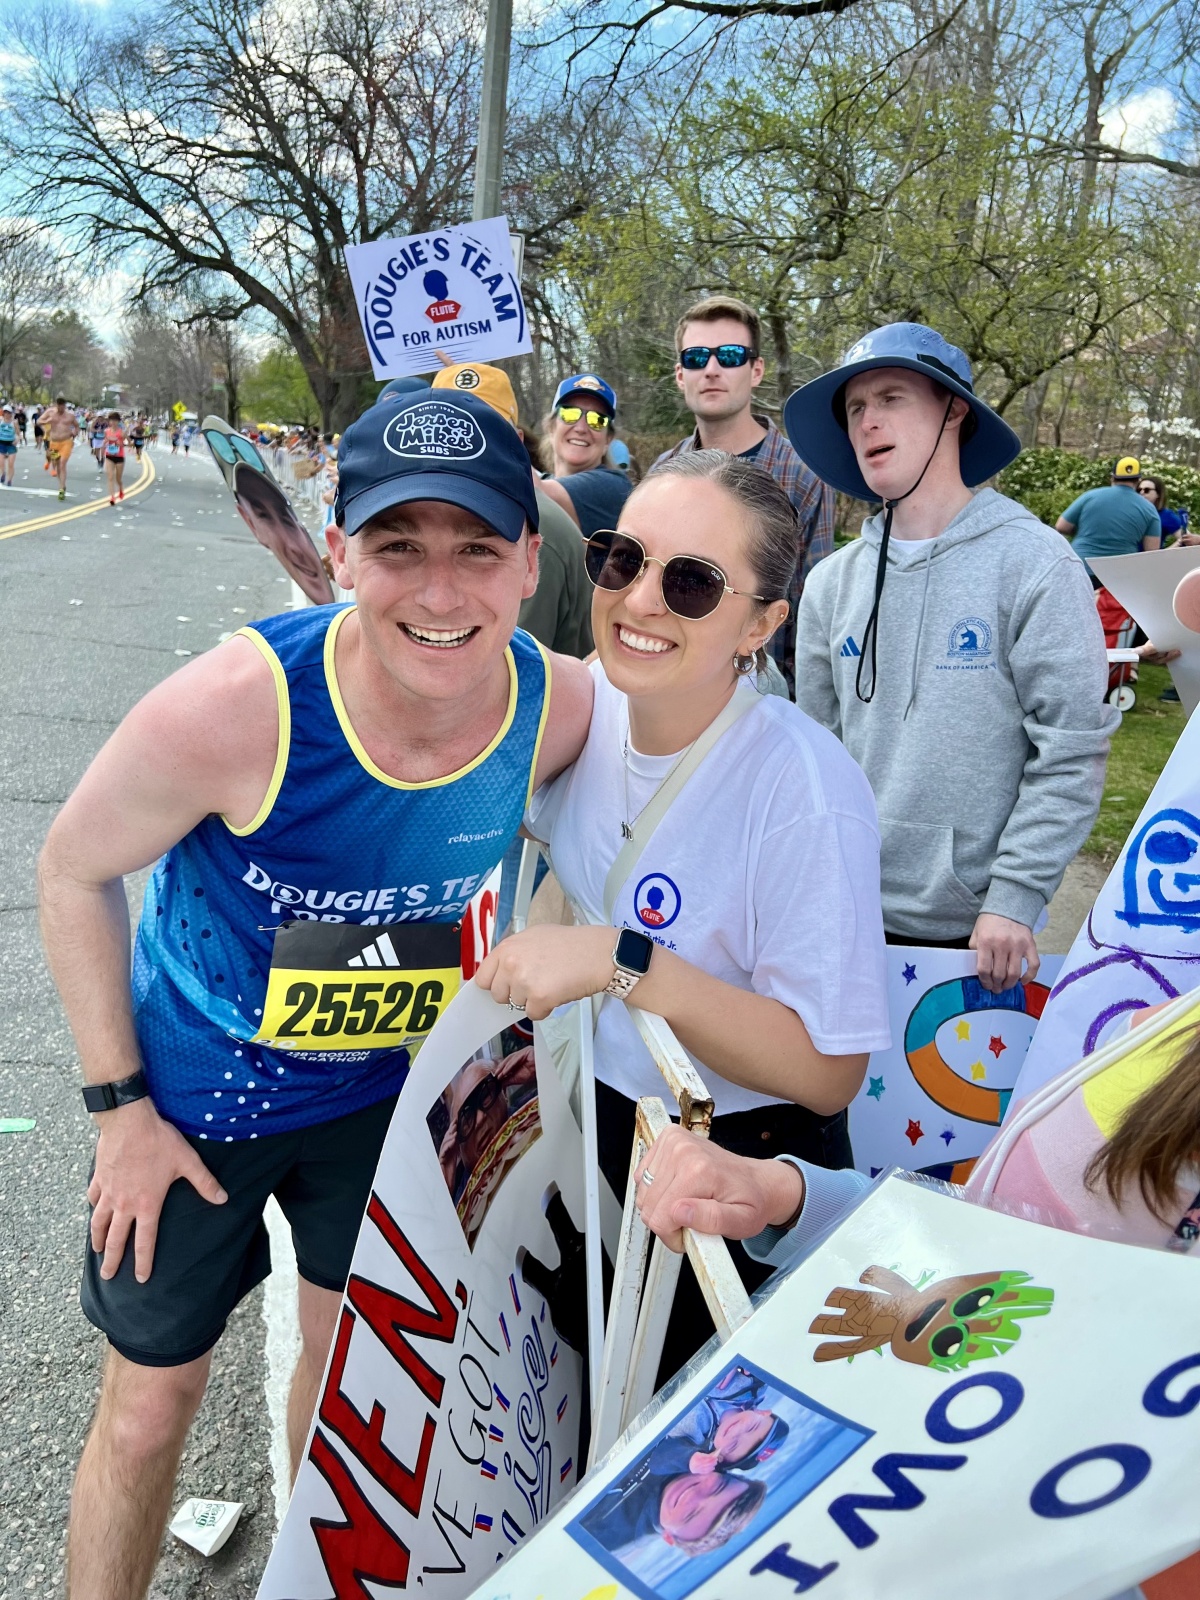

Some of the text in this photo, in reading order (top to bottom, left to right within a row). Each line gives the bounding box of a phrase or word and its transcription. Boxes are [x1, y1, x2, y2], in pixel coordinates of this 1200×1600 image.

[371, 237, 518, 341] DOUGIE'S TEAM
[430, 304, 456, 317] FLUTIE
[402, 319, 492, 347] FOR AUTISM
[396, 413, 475, 438] Jersey
[420, 446, 450, 456] SUBS
[447, 828, 504, 845] relayactive
[666, 940, 677, 951] Jr.
[275, 980, 445, 1038] 25526
[317, 1050, 371, 1058] BOSTON
[447, 1290, 500, 1465] GOT
